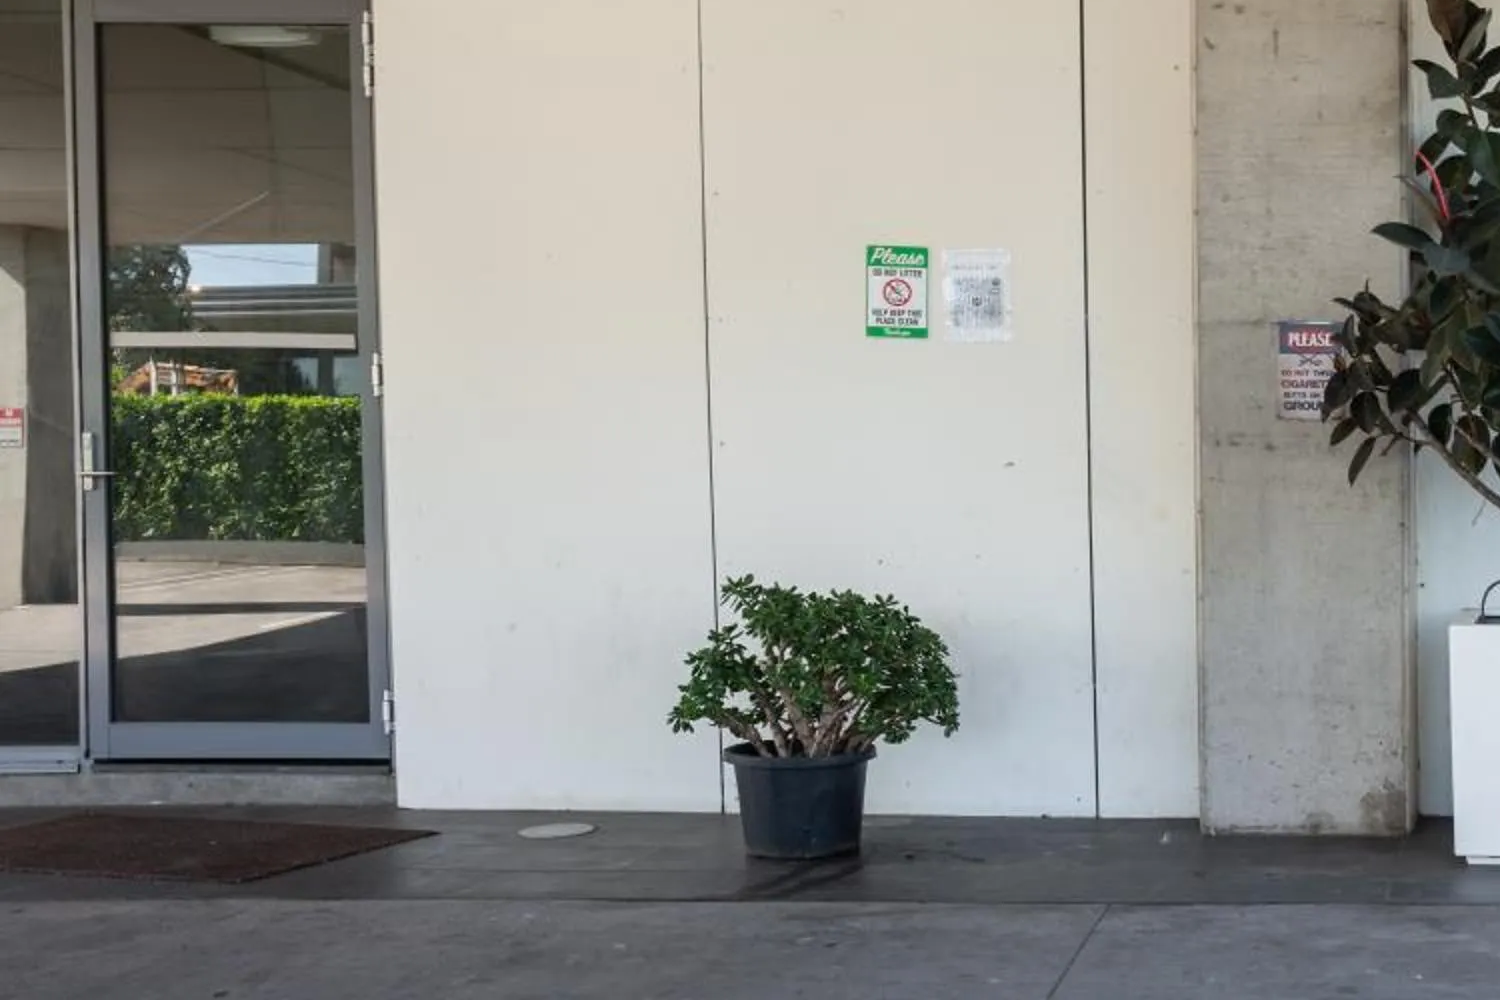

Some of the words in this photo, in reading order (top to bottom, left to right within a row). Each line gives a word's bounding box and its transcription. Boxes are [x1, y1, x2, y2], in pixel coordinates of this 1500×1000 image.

[870, 247, 925, 265] Please
[1287, 331, 1334, 347] PLEASE
[1283, 401, 1323, 411] GROU
